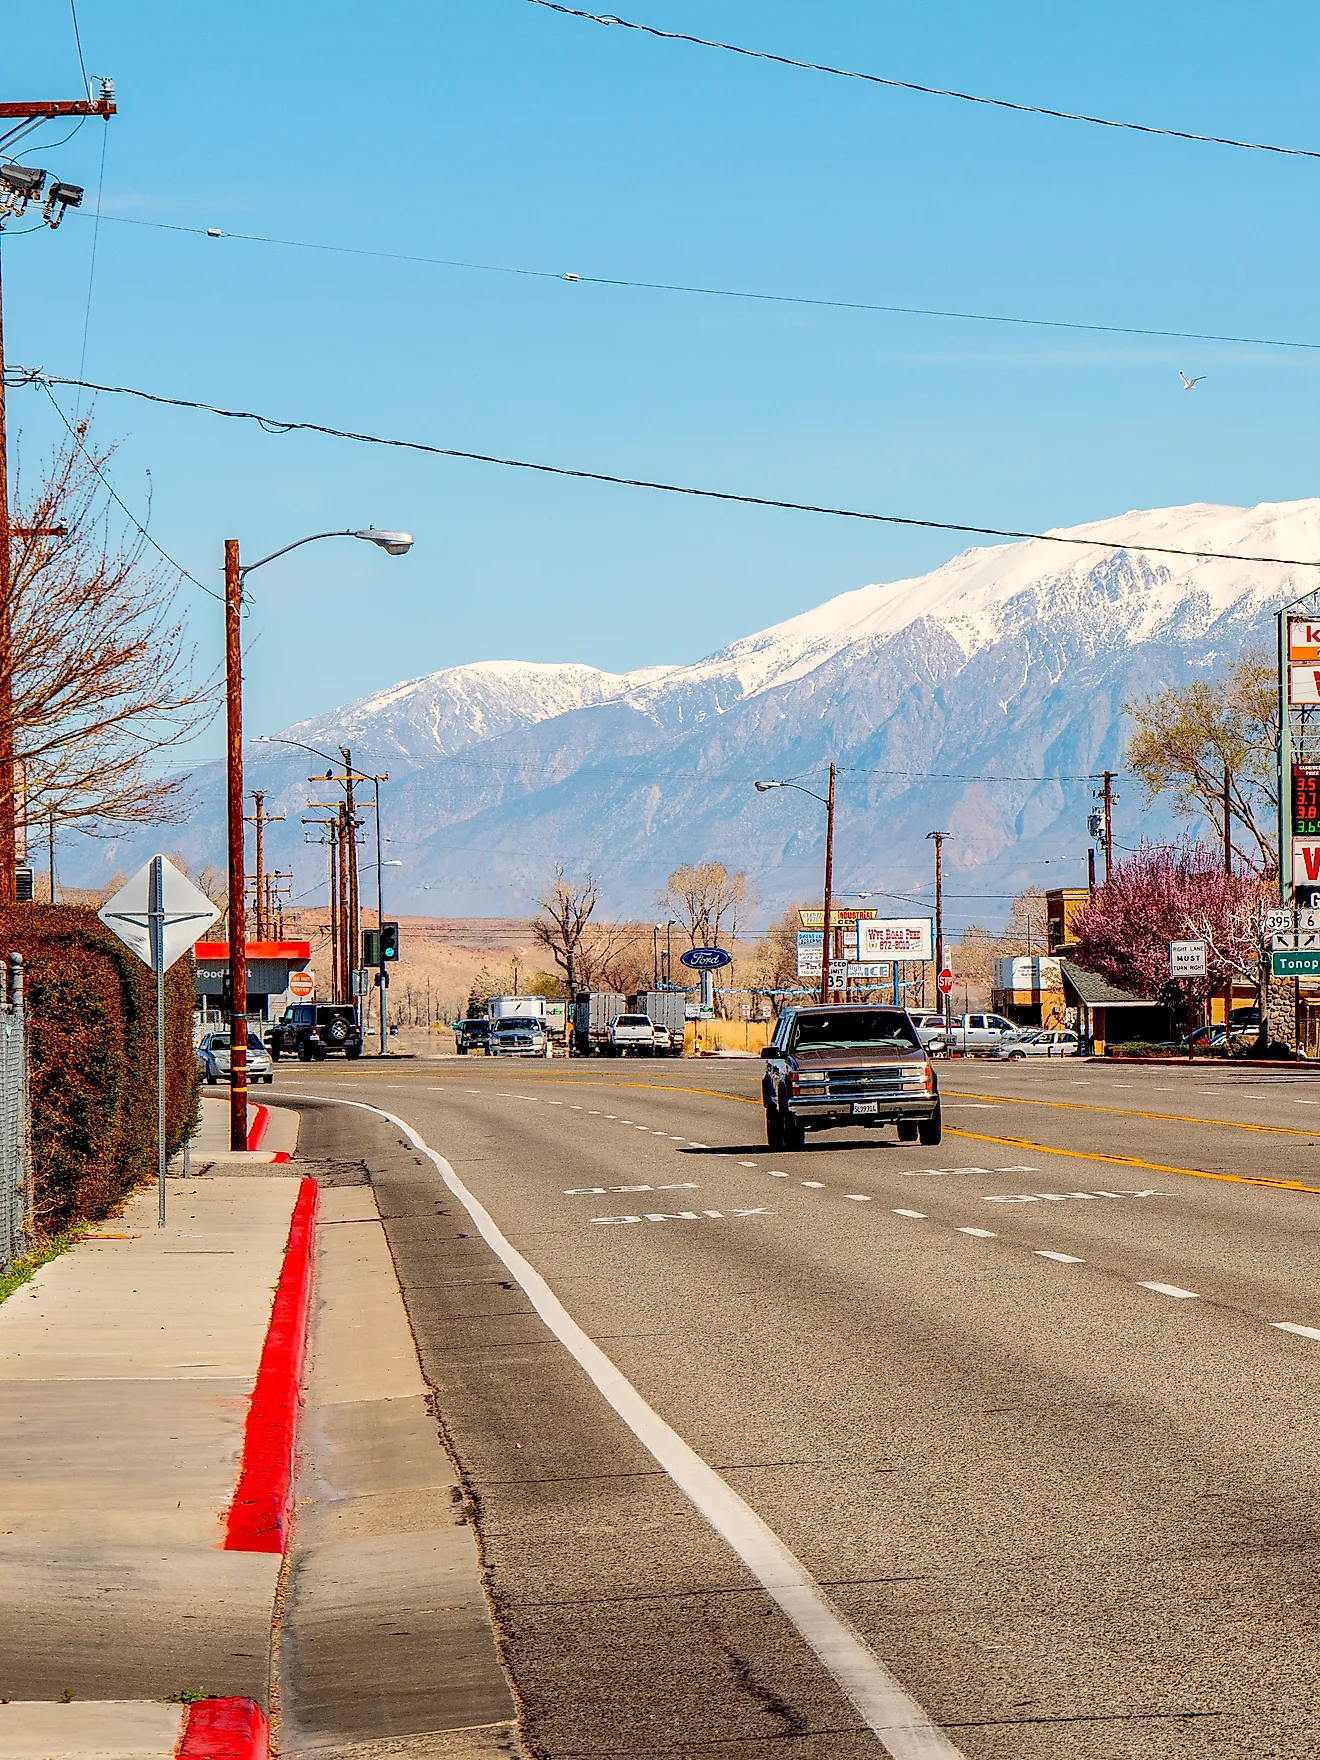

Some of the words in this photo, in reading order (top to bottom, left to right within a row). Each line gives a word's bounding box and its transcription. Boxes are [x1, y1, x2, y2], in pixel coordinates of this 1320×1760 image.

[1268, 916, 1290, 928] 395
[1307, 915, 1315, 927] 6
[690, 952, 720, 965] Ford
[196, 969, 224, 978] Food
[864, 966, 888, 977] ICE
[828, 976, 844, 988] 35
